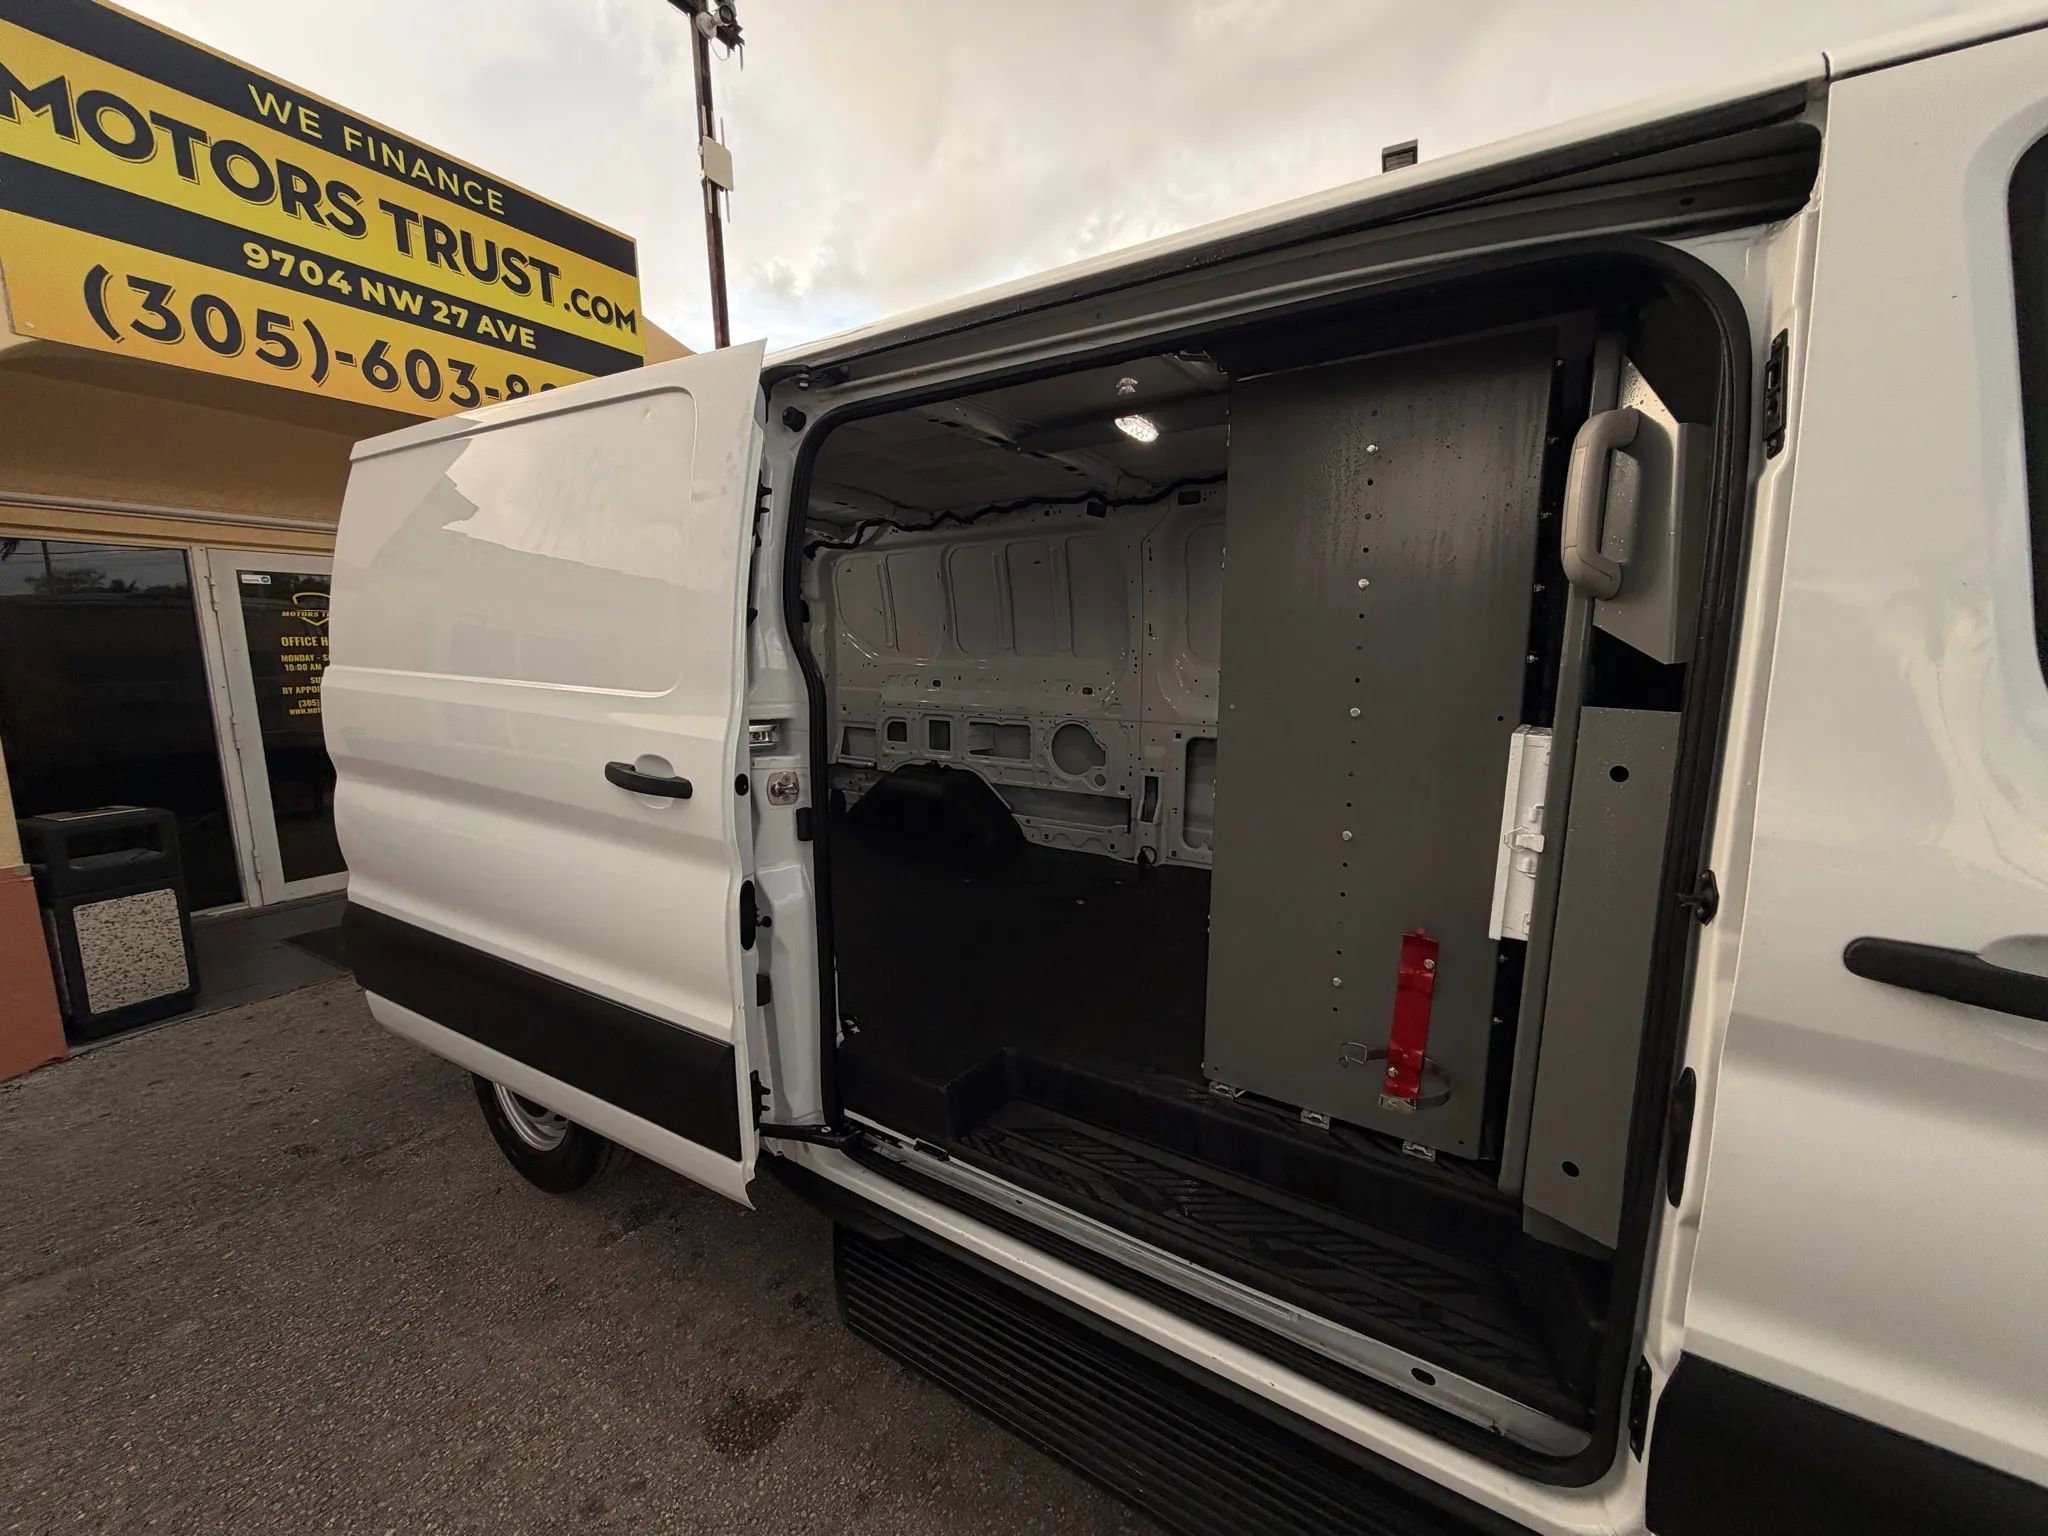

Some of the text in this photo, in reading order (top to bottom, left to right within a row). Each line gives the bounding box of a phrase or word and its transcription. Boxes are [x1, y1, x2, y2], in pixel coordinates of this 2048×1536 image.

[0, 62, 367, 240] MOTORS
[248, 83, 505, 215] WE FINANCE
[83, 263, 559, 409] (305)-603-8
[242, 242, 537, 350] 9704 NW 27 AVE
[281, 636, 318, 647] OFFICE
[281, 654, 315, 662] MONDAY
[298, 699, 320, 708] (305)
